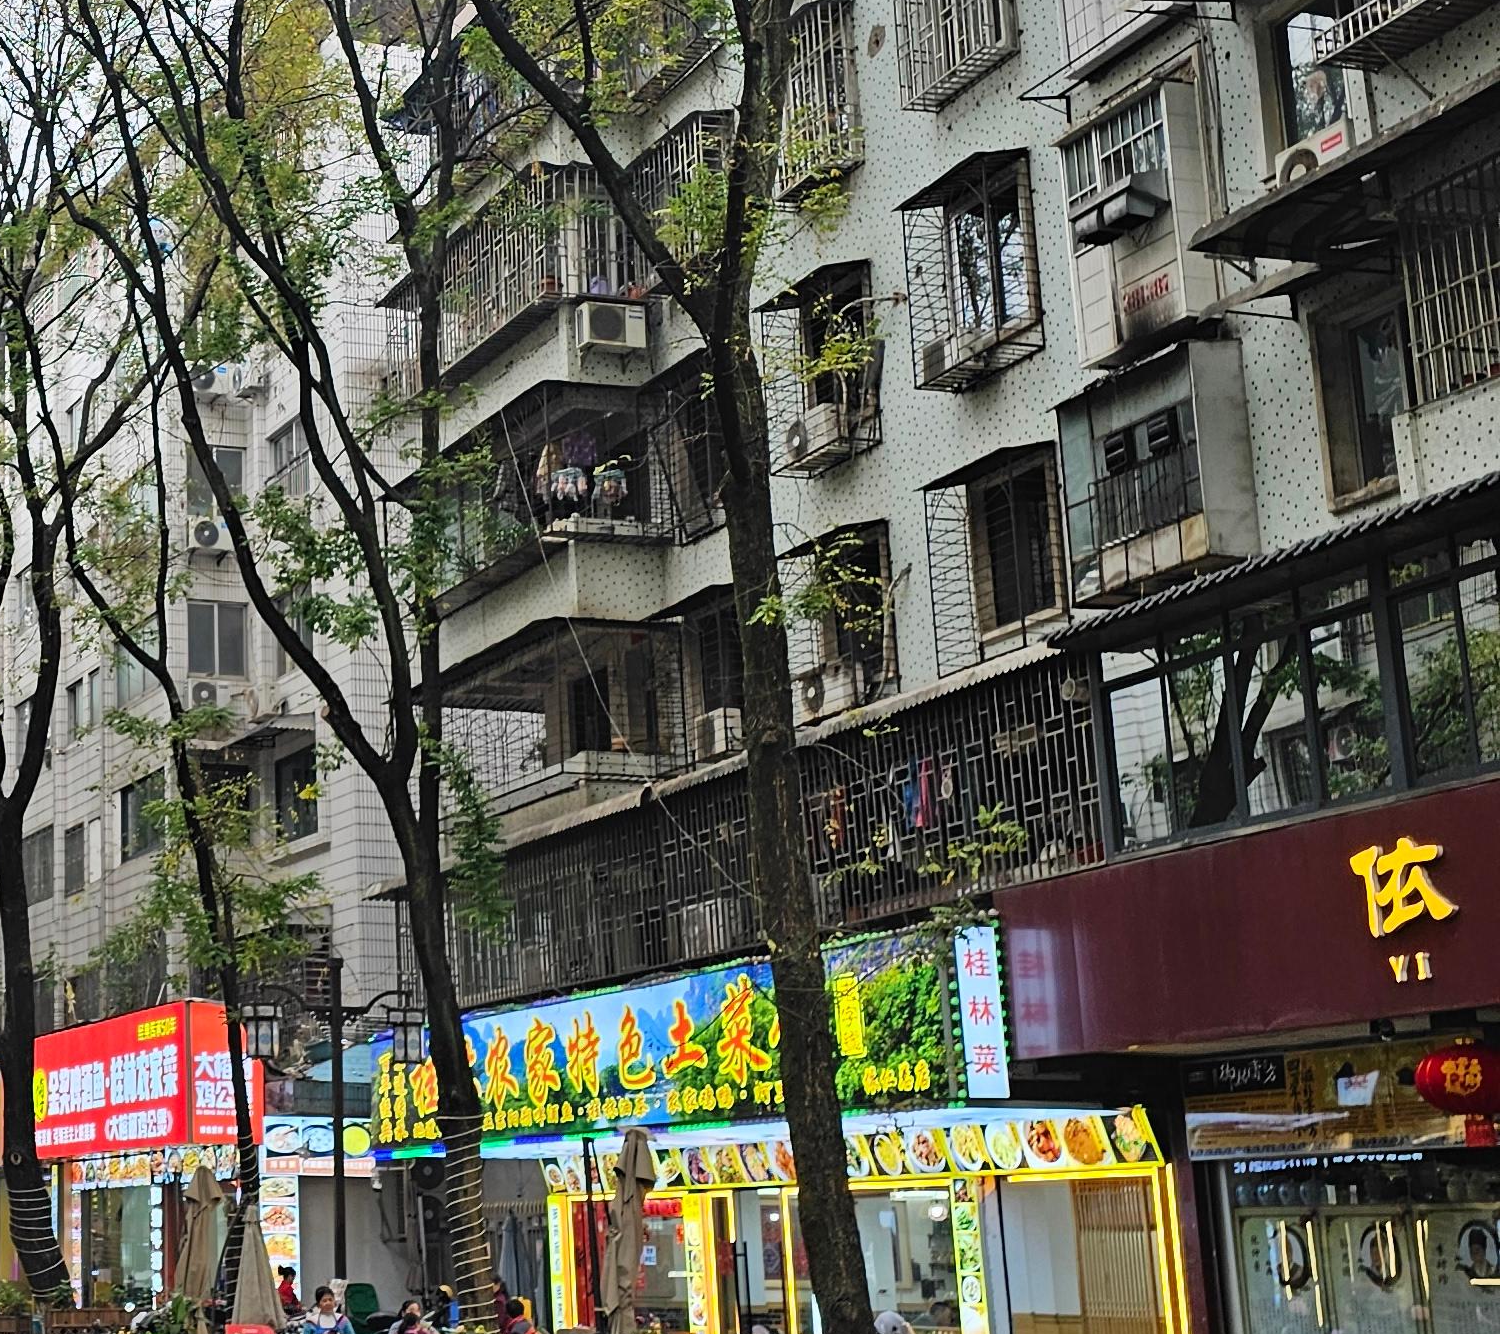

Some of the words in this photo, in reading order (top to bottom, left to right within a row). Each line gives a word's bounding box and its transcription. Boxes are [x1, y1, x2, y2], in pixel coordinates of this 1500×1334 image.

[1350, 836, 1459, 938] 依
[409, 972, 781, 1119] 桂农家特色土菜
[963, 947, 1001, 1076] 桂林菜
